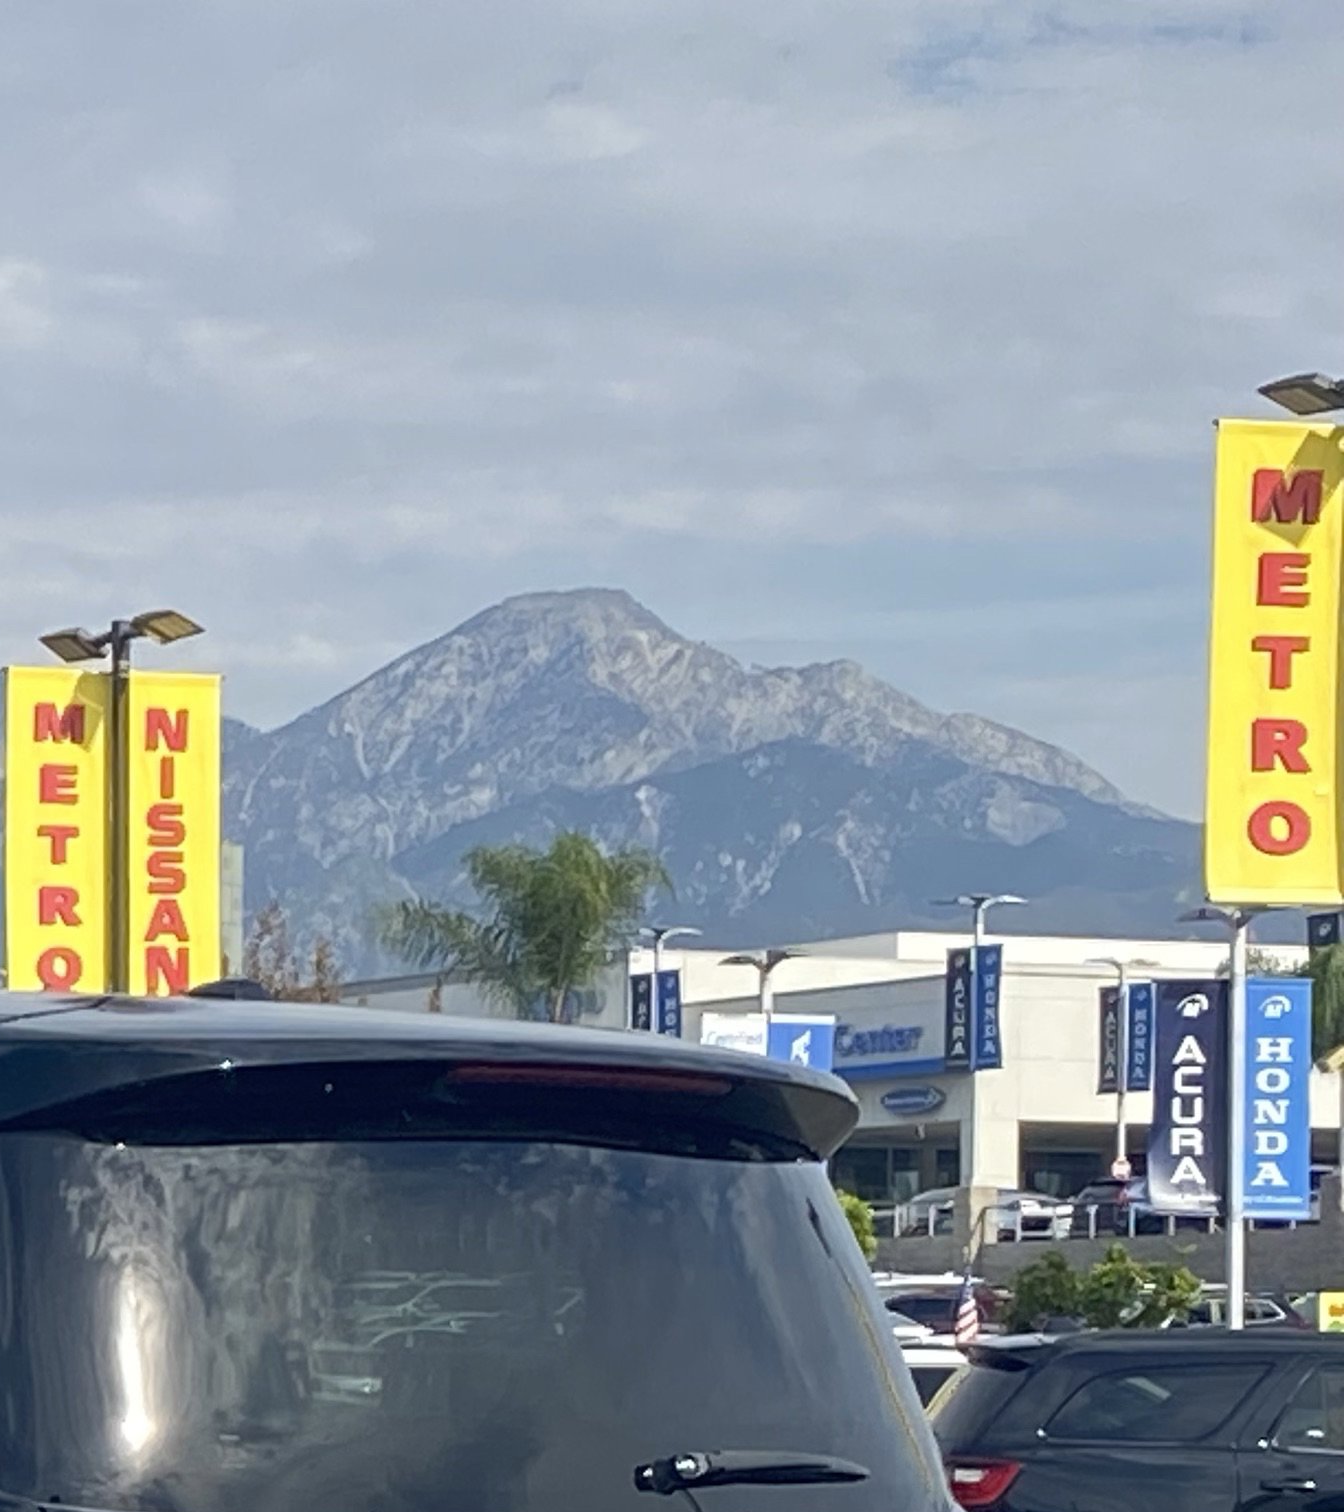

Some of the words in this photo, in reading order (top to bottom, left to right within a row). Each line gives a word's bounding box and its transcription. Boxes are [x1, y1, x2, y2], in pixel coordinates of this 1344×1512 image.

[1247, 469, 1325, 857] METRO
[34, 702, 86, 992] METRO
[144, 708, 190, 996] NISSAN
[834, 1023, 923, 1057] Center
[951, 976, 967, 1058] ACURA
[983, 973, 997, 1054] HONDA
[1170, 1035, 1207, 1184] ACURA
[1250, 1037, 1294, 1187] HONDA
